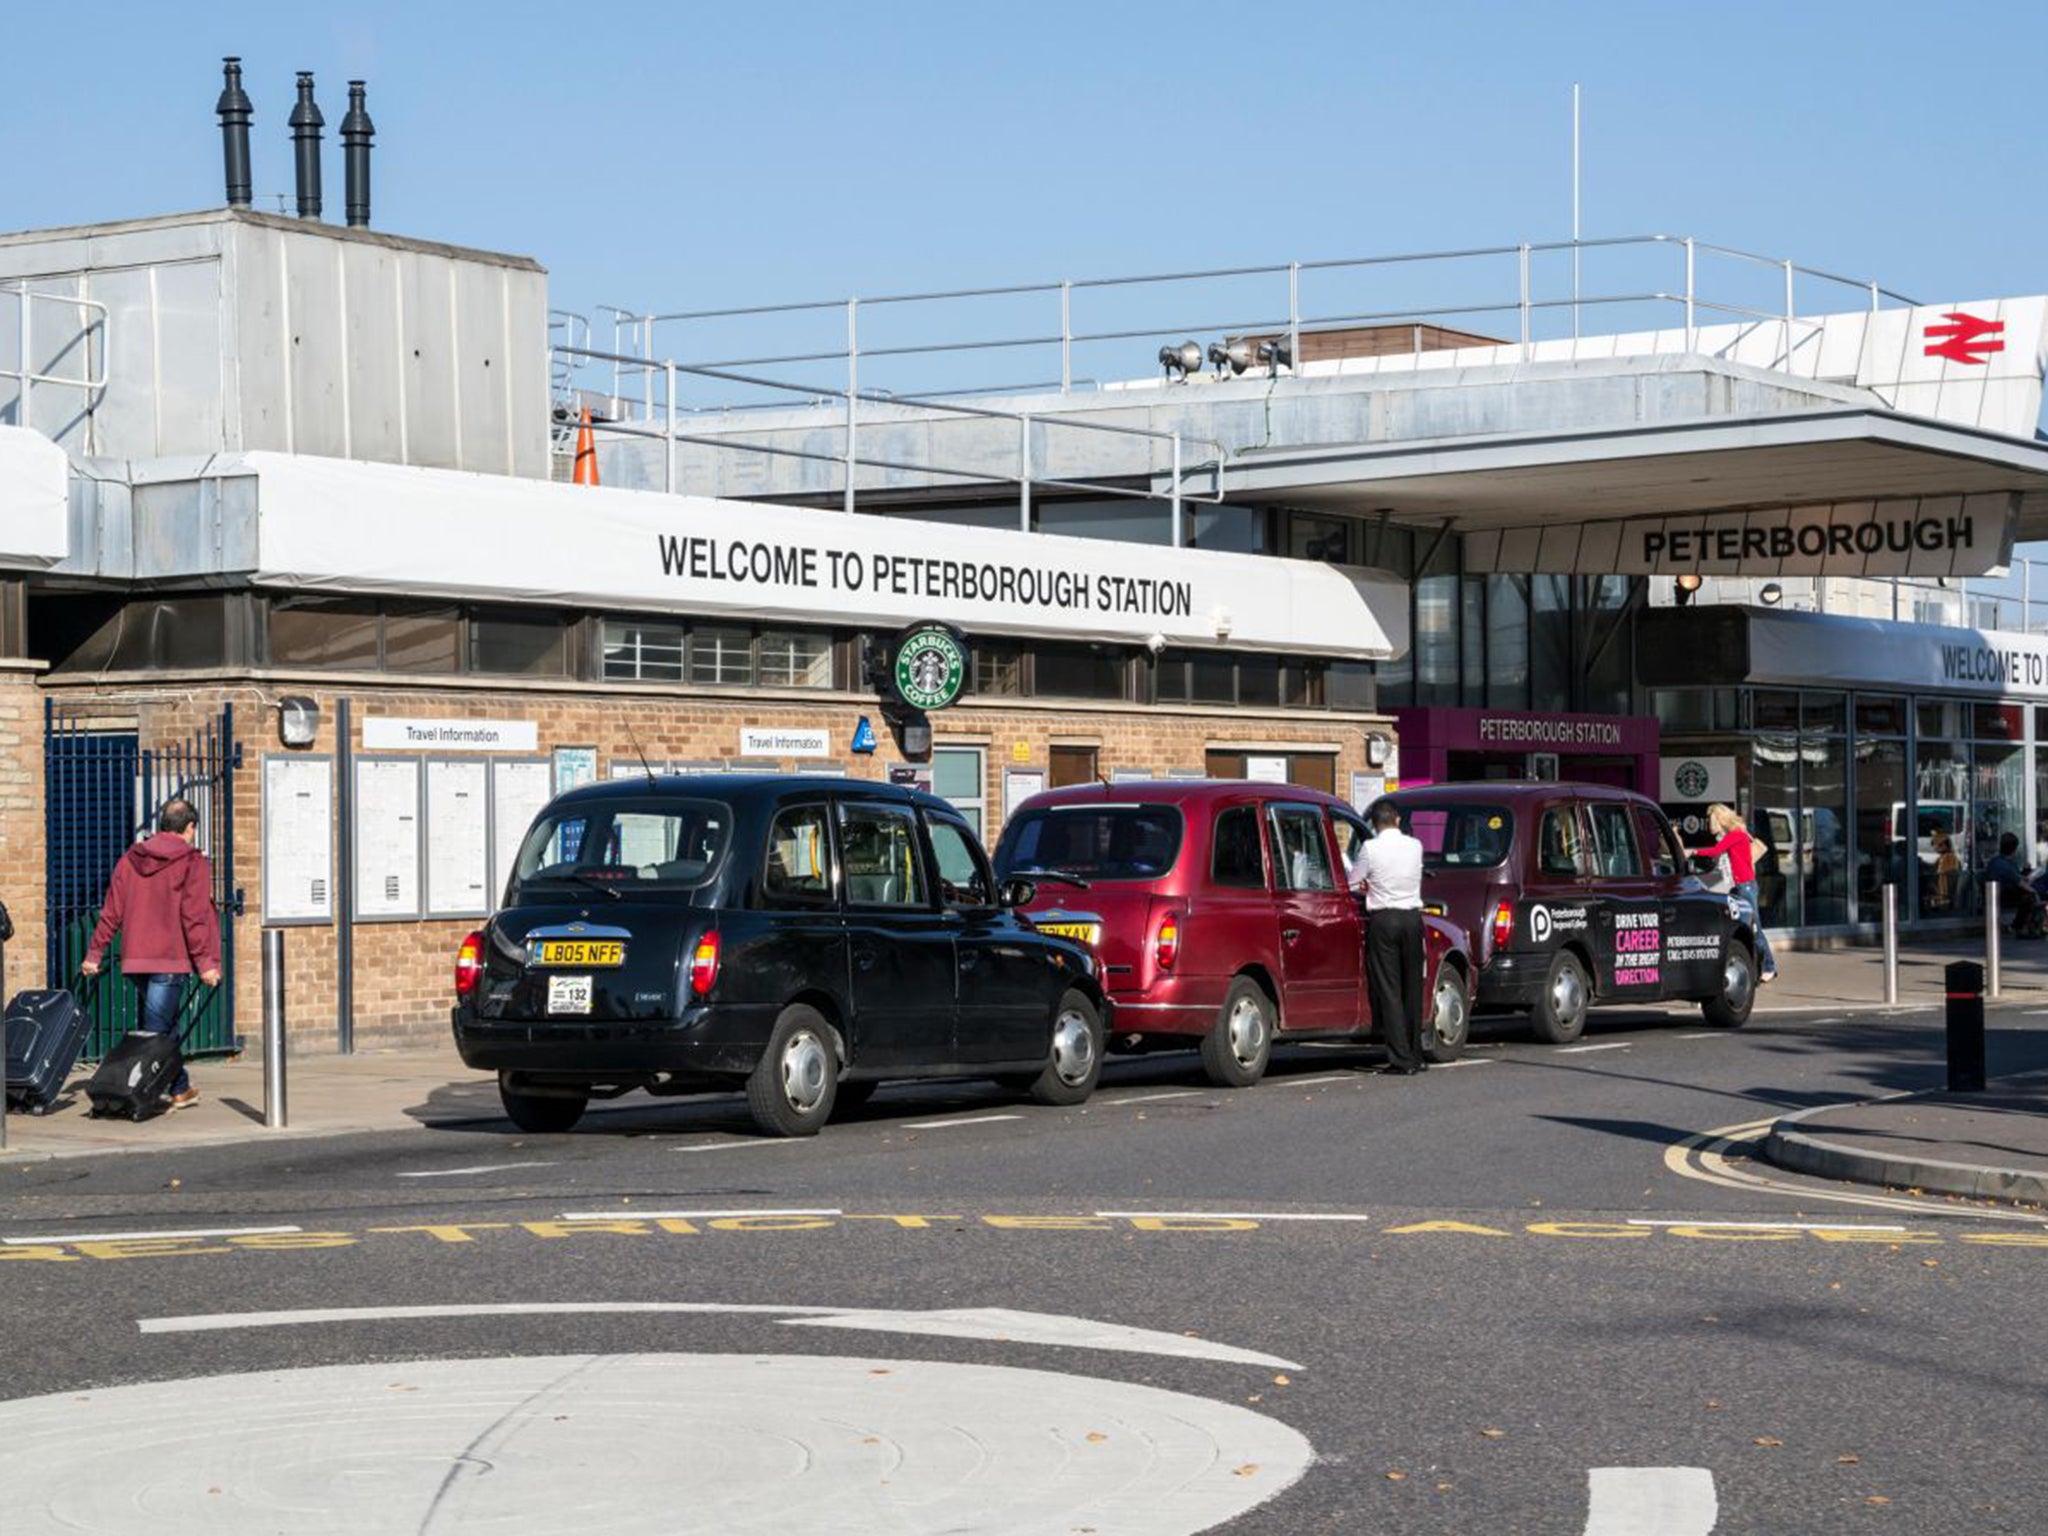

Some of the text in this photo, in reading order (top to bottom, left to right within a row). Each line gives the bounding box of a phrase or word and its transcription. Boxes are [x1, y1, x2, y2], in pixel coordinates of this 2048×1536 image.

[1643, 516, 1974, 562] PETERBOROUGH
[658, 534, 1191, 616] WELCOME TO PETERBOROUGH STATION
[900, 635, 960, 670] STARBUCKS
[1941, 644, 2020, 684] WELCOME
[2023, 652, 2042, 685] TO
[904, 684, 949, 706] COFFEE
[406, 726, 499, 742] Travel Information
[1480, 718, 1621, 744] PETERBOROUGH STATION
[748, 735, 823, 749] Travel Information
[1615, 913, 1659, 929] DRIVE YOUR
[1616, 929, 1660, 952] CAREER
[544, 945, 620, 961] LB05 NFF
[1615, 953, 1624, 967] IN
[1624, 952, 1638, 967] THE
[1638, 952, 1660, 966] RIGHT
[1615, 967, 1660, 985] DIRECTION
[568, 988, 587, 1001] 132
